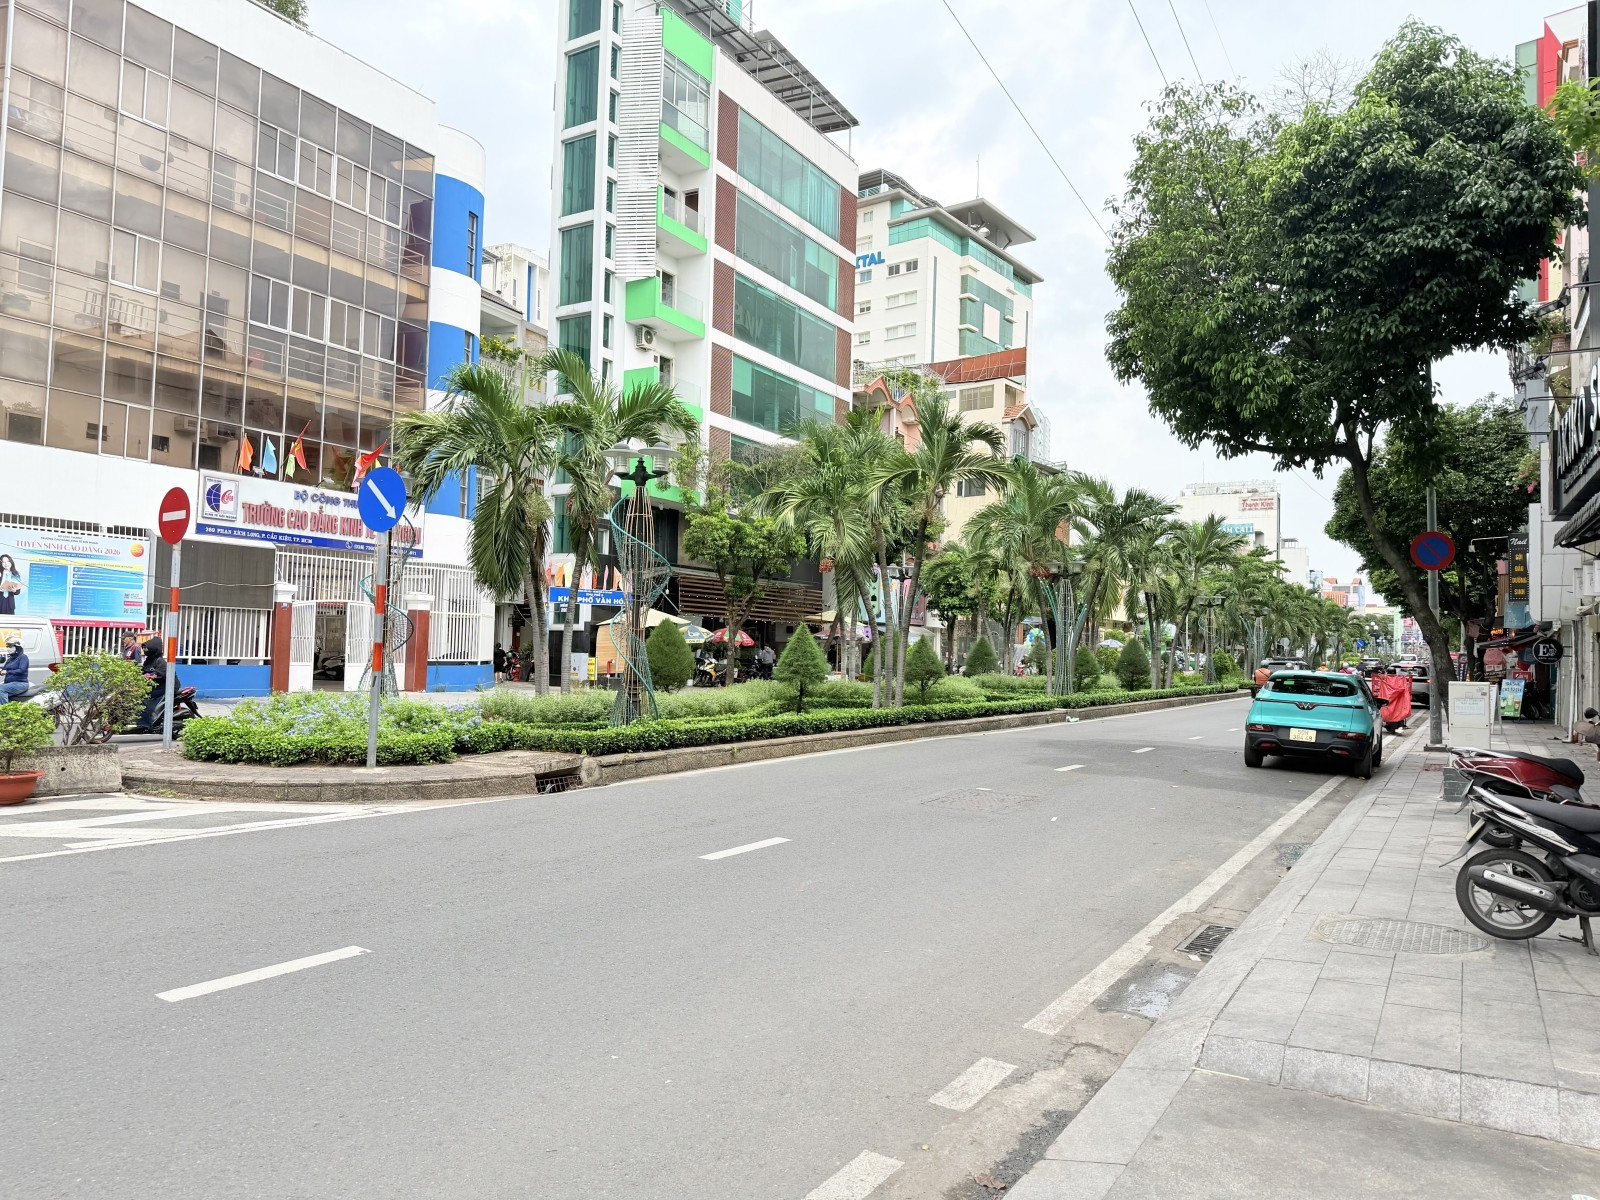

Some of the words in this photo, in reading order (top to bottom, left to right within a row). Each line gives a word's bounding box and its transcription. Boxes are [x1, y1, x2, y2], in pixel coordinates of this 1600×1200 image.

[294, 490, 309, 503] BỘ
[310, 492, 341, 507] CÔNG
[242, 501, 285, 528] TRƯỜNG
[287, 508, 309, 531] CAO
[310, 505, 339, 535] ĐẲNG
[340, 516, 363, 538] KINH
[42, 542, 63, 550] SINH
[104, 547, 121, 555] 2026
[577, 595, 594, 603] PHỐ
[613, 597, 625, 605] HÓ
